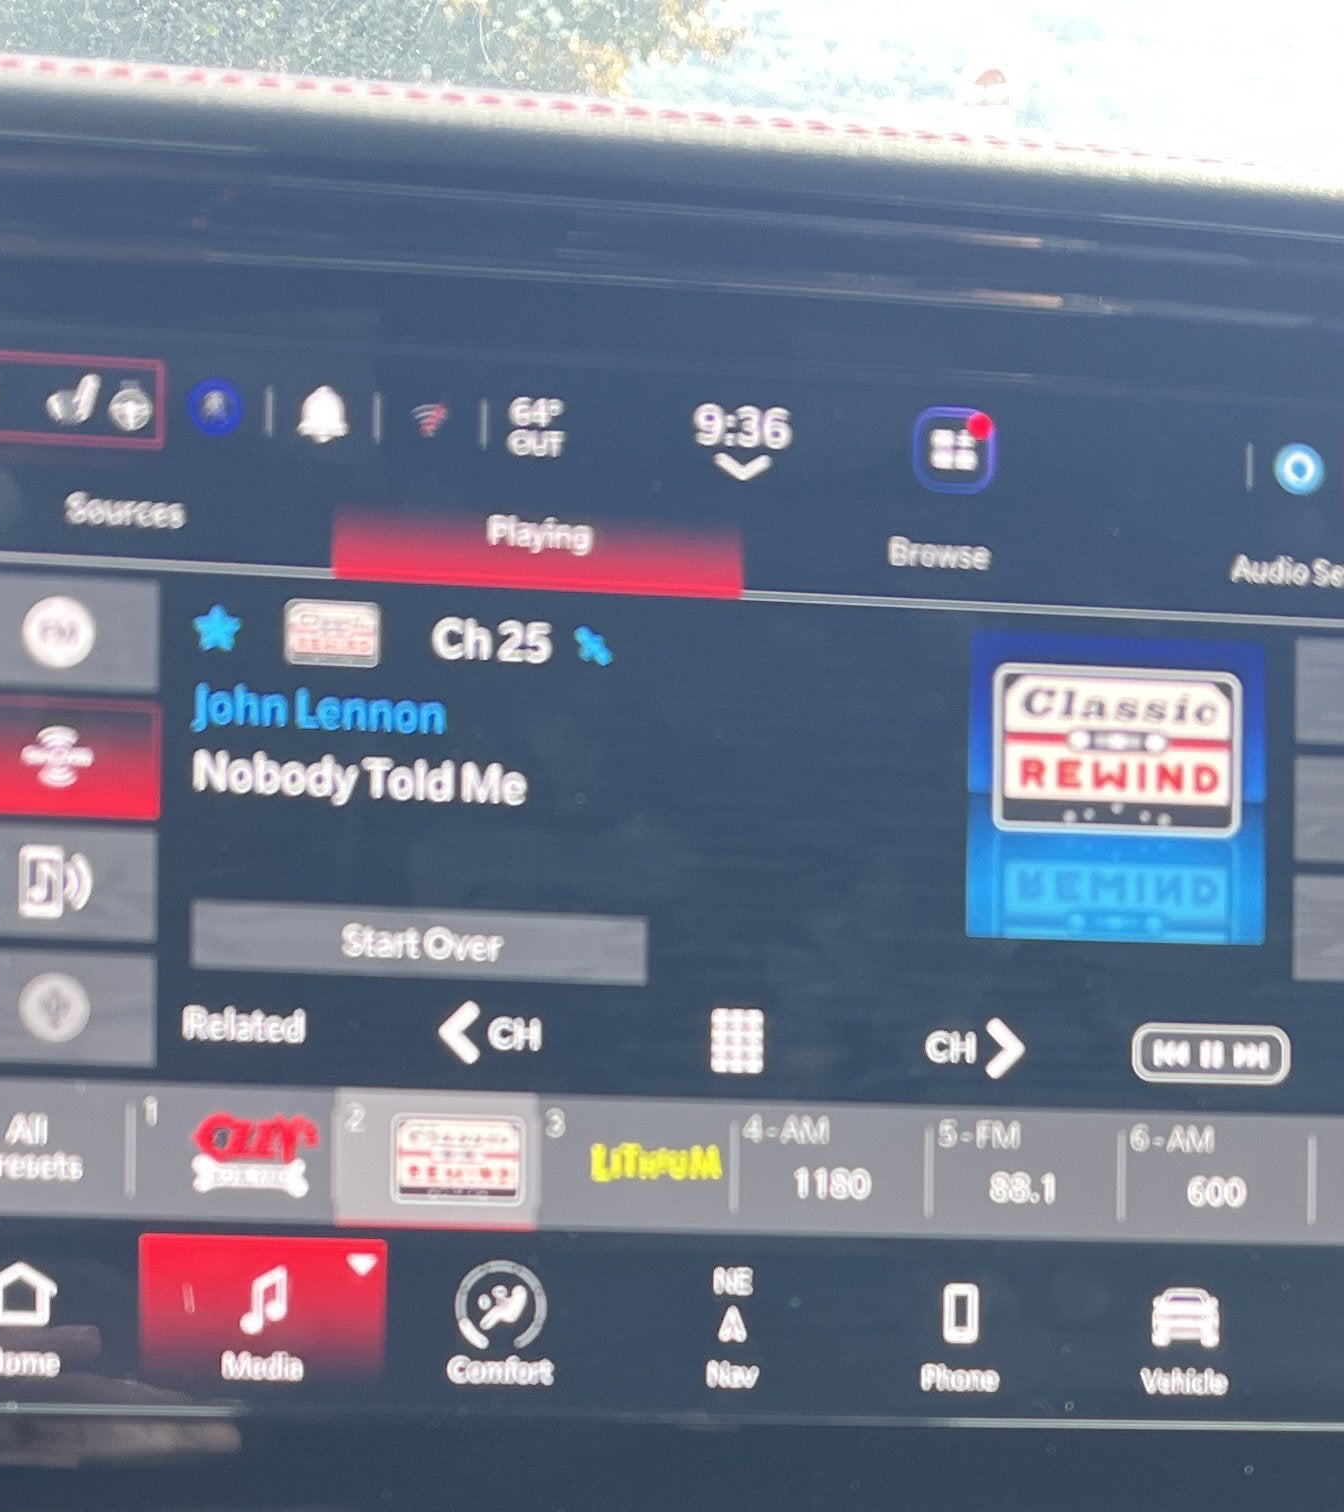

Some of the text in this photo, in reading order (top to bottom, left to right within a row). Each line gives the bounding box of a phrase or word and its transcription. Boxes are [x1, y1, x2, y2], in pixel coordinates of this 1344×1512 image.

[507, 429, 566, 458] OUT
[692, 402, 792, 451] 9:36
[65, 491, 186, 530] Sources
[486, 514, 594, 556] Playing
[888, 536, 992, 572] Browse
[1231, 553, 1309, 587] Audio
[432, 616, 553, 664] Ch 25
[190, 681, 446, 736] John Lennon
[1022, 687, 1219, 726] Classic
[192, 750, 529, 807] Nobody Told Me
[1019, 758, 1221, 794] REWIND
[341, 922, 503, 963] Start Over
[182, 1006, 306, 1044] Related
[488, 1018, 542, 1052] CH
[925, 1031, 977, 1065] CH
[144, 1096, 159, 1125] 1
[344, 1104, 367, 1133] 2
[545, 1107, 567, 1138] 3
[4, 1112, 48, 1146] All
[741, 1115, 830, 1145] 4-AM
[938, 1119, 1022, 1150] 5-FM
[1130, 1123, 1216, 1155] 6-AM
[793, 1166, 872, 1200] 1180
[989, 1171, 1057, 1204] 88.1
[1187, 1175, 1247, 1208] 600
[712, 1266, 754, 1297] NE
[220, 1350, 304, 1382] Media
[446, 1352, 555, 1387] Comfort
[704, 1359, 760, 1391] Nav
[919, 1362, 1000, 1394] Phone
[1140, 1365, 1229, 1398] Vehicle
